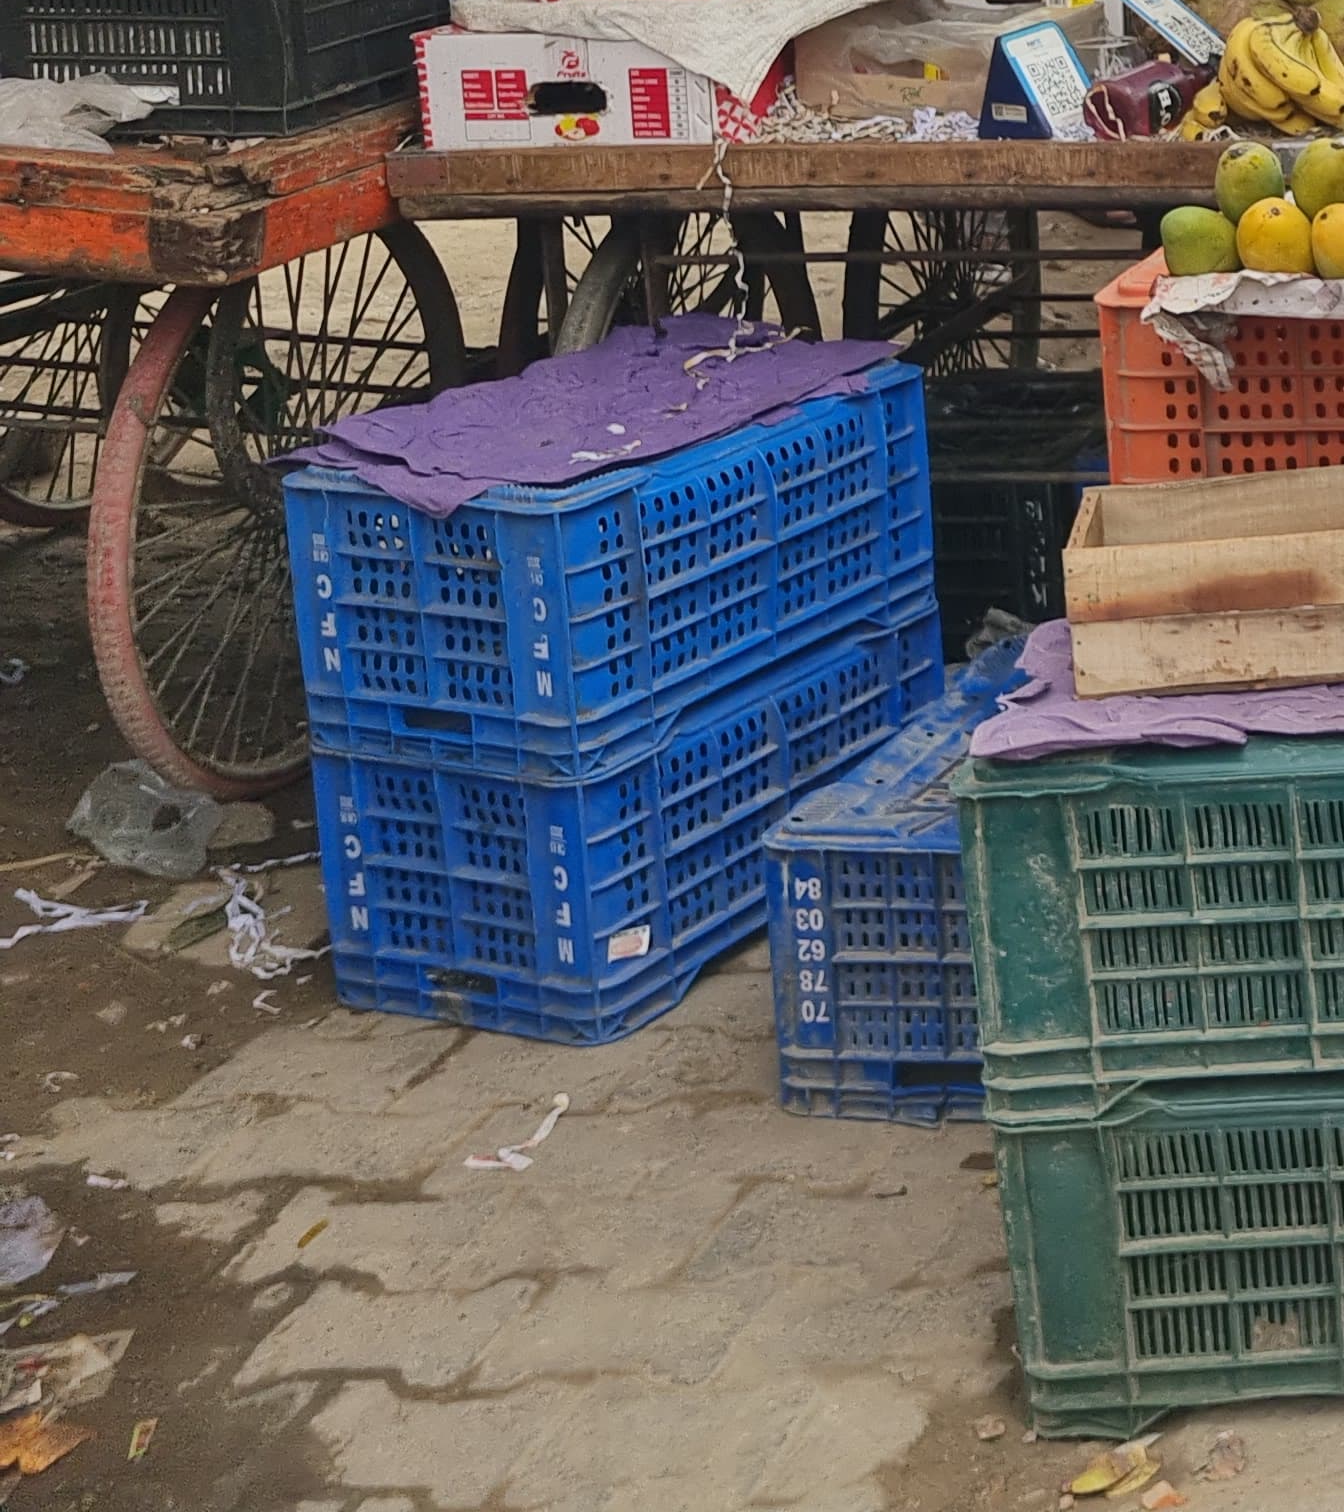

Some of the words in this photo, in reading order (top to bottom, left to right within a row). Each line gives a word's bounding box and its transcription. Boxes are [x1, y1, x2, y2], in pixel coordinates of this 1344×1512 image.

[794, 877, 822, 901] 84
[796, 908, 824, 932] 03
[798, 938, 826, 962] 62
[800, 969, 829, 993] 78
[802, 999, 831, 1023] 70
